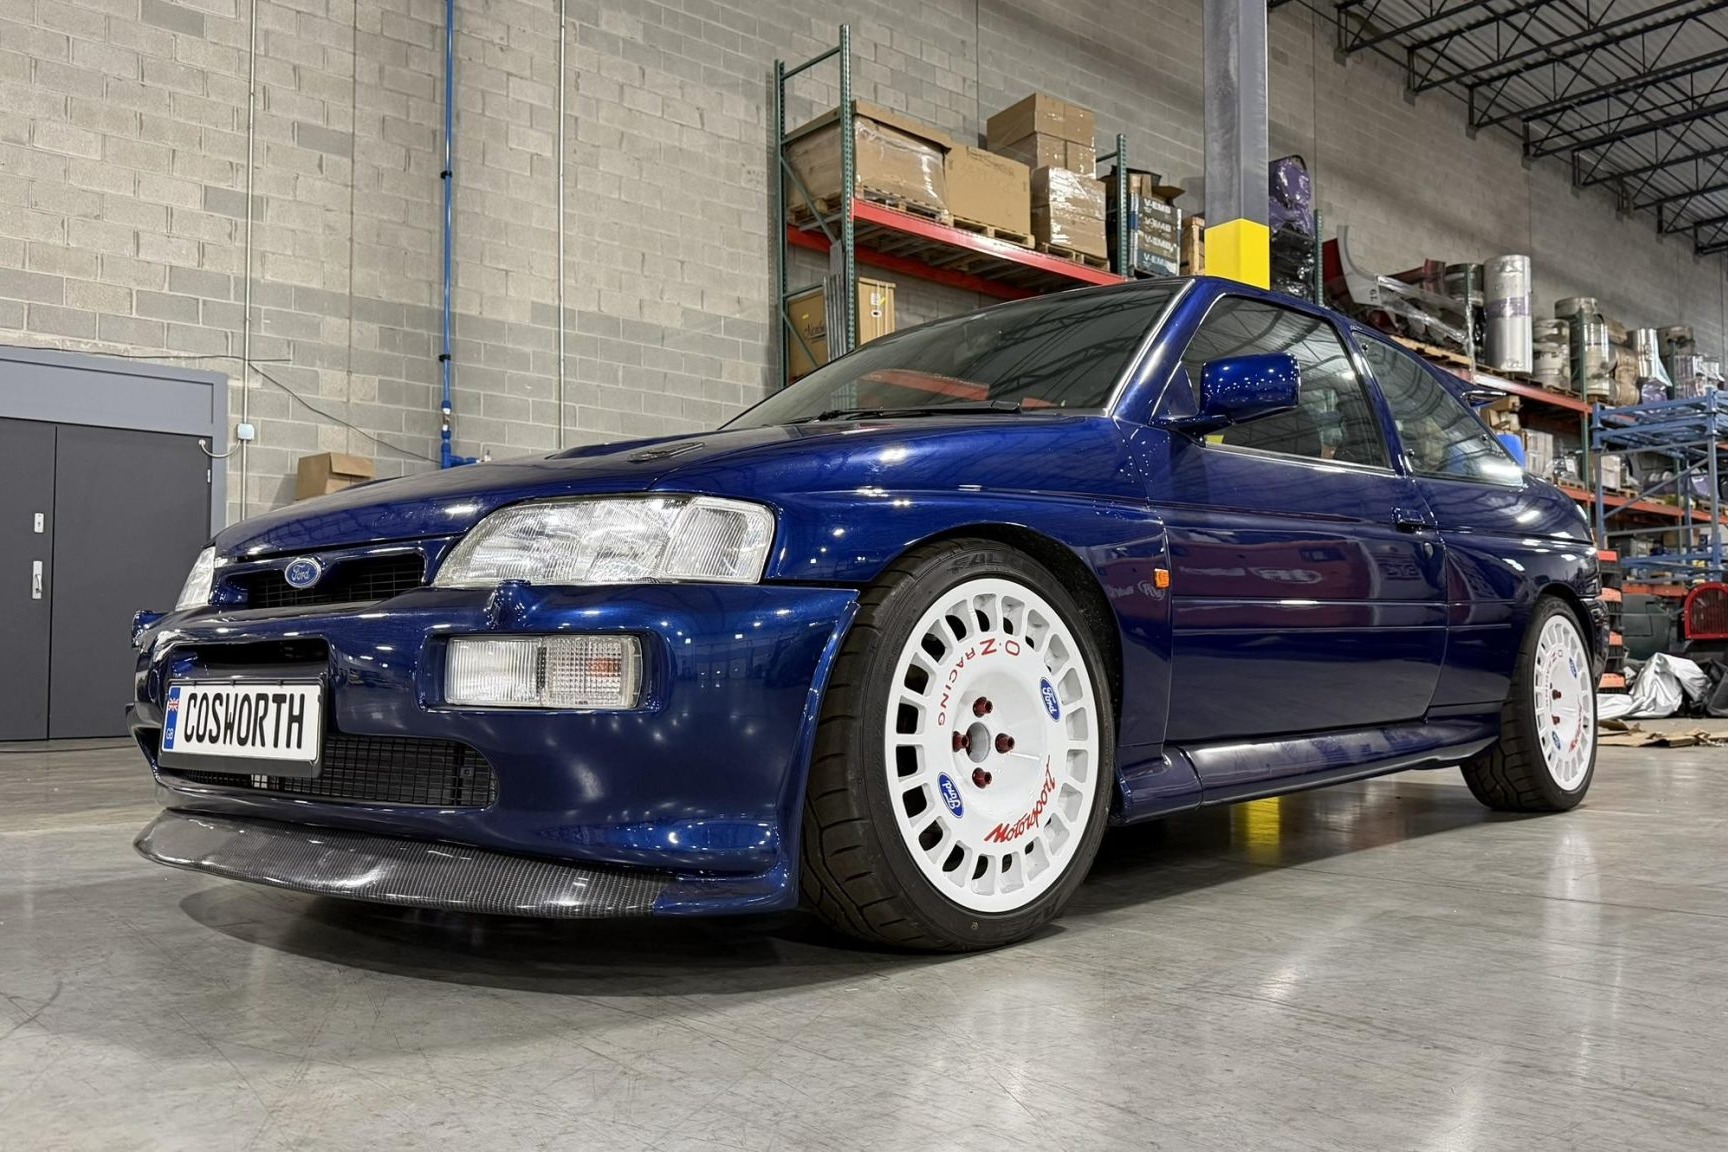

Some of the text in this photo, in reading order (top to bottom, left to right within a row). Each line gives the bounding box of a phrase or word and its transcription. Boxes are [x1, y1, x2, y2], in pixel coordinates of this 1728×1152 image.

[291, 564, 311, 581] Ford
[937, 647, 976, 726] RACING
[1042, 686, 1058, 715] Ford
[165, 728, 174, 740] GB
[184, 691, 306, 749] COSWORTH
[941, 779, 961, 810] Ford
[983, 754, 1056, 844] Motorsport
